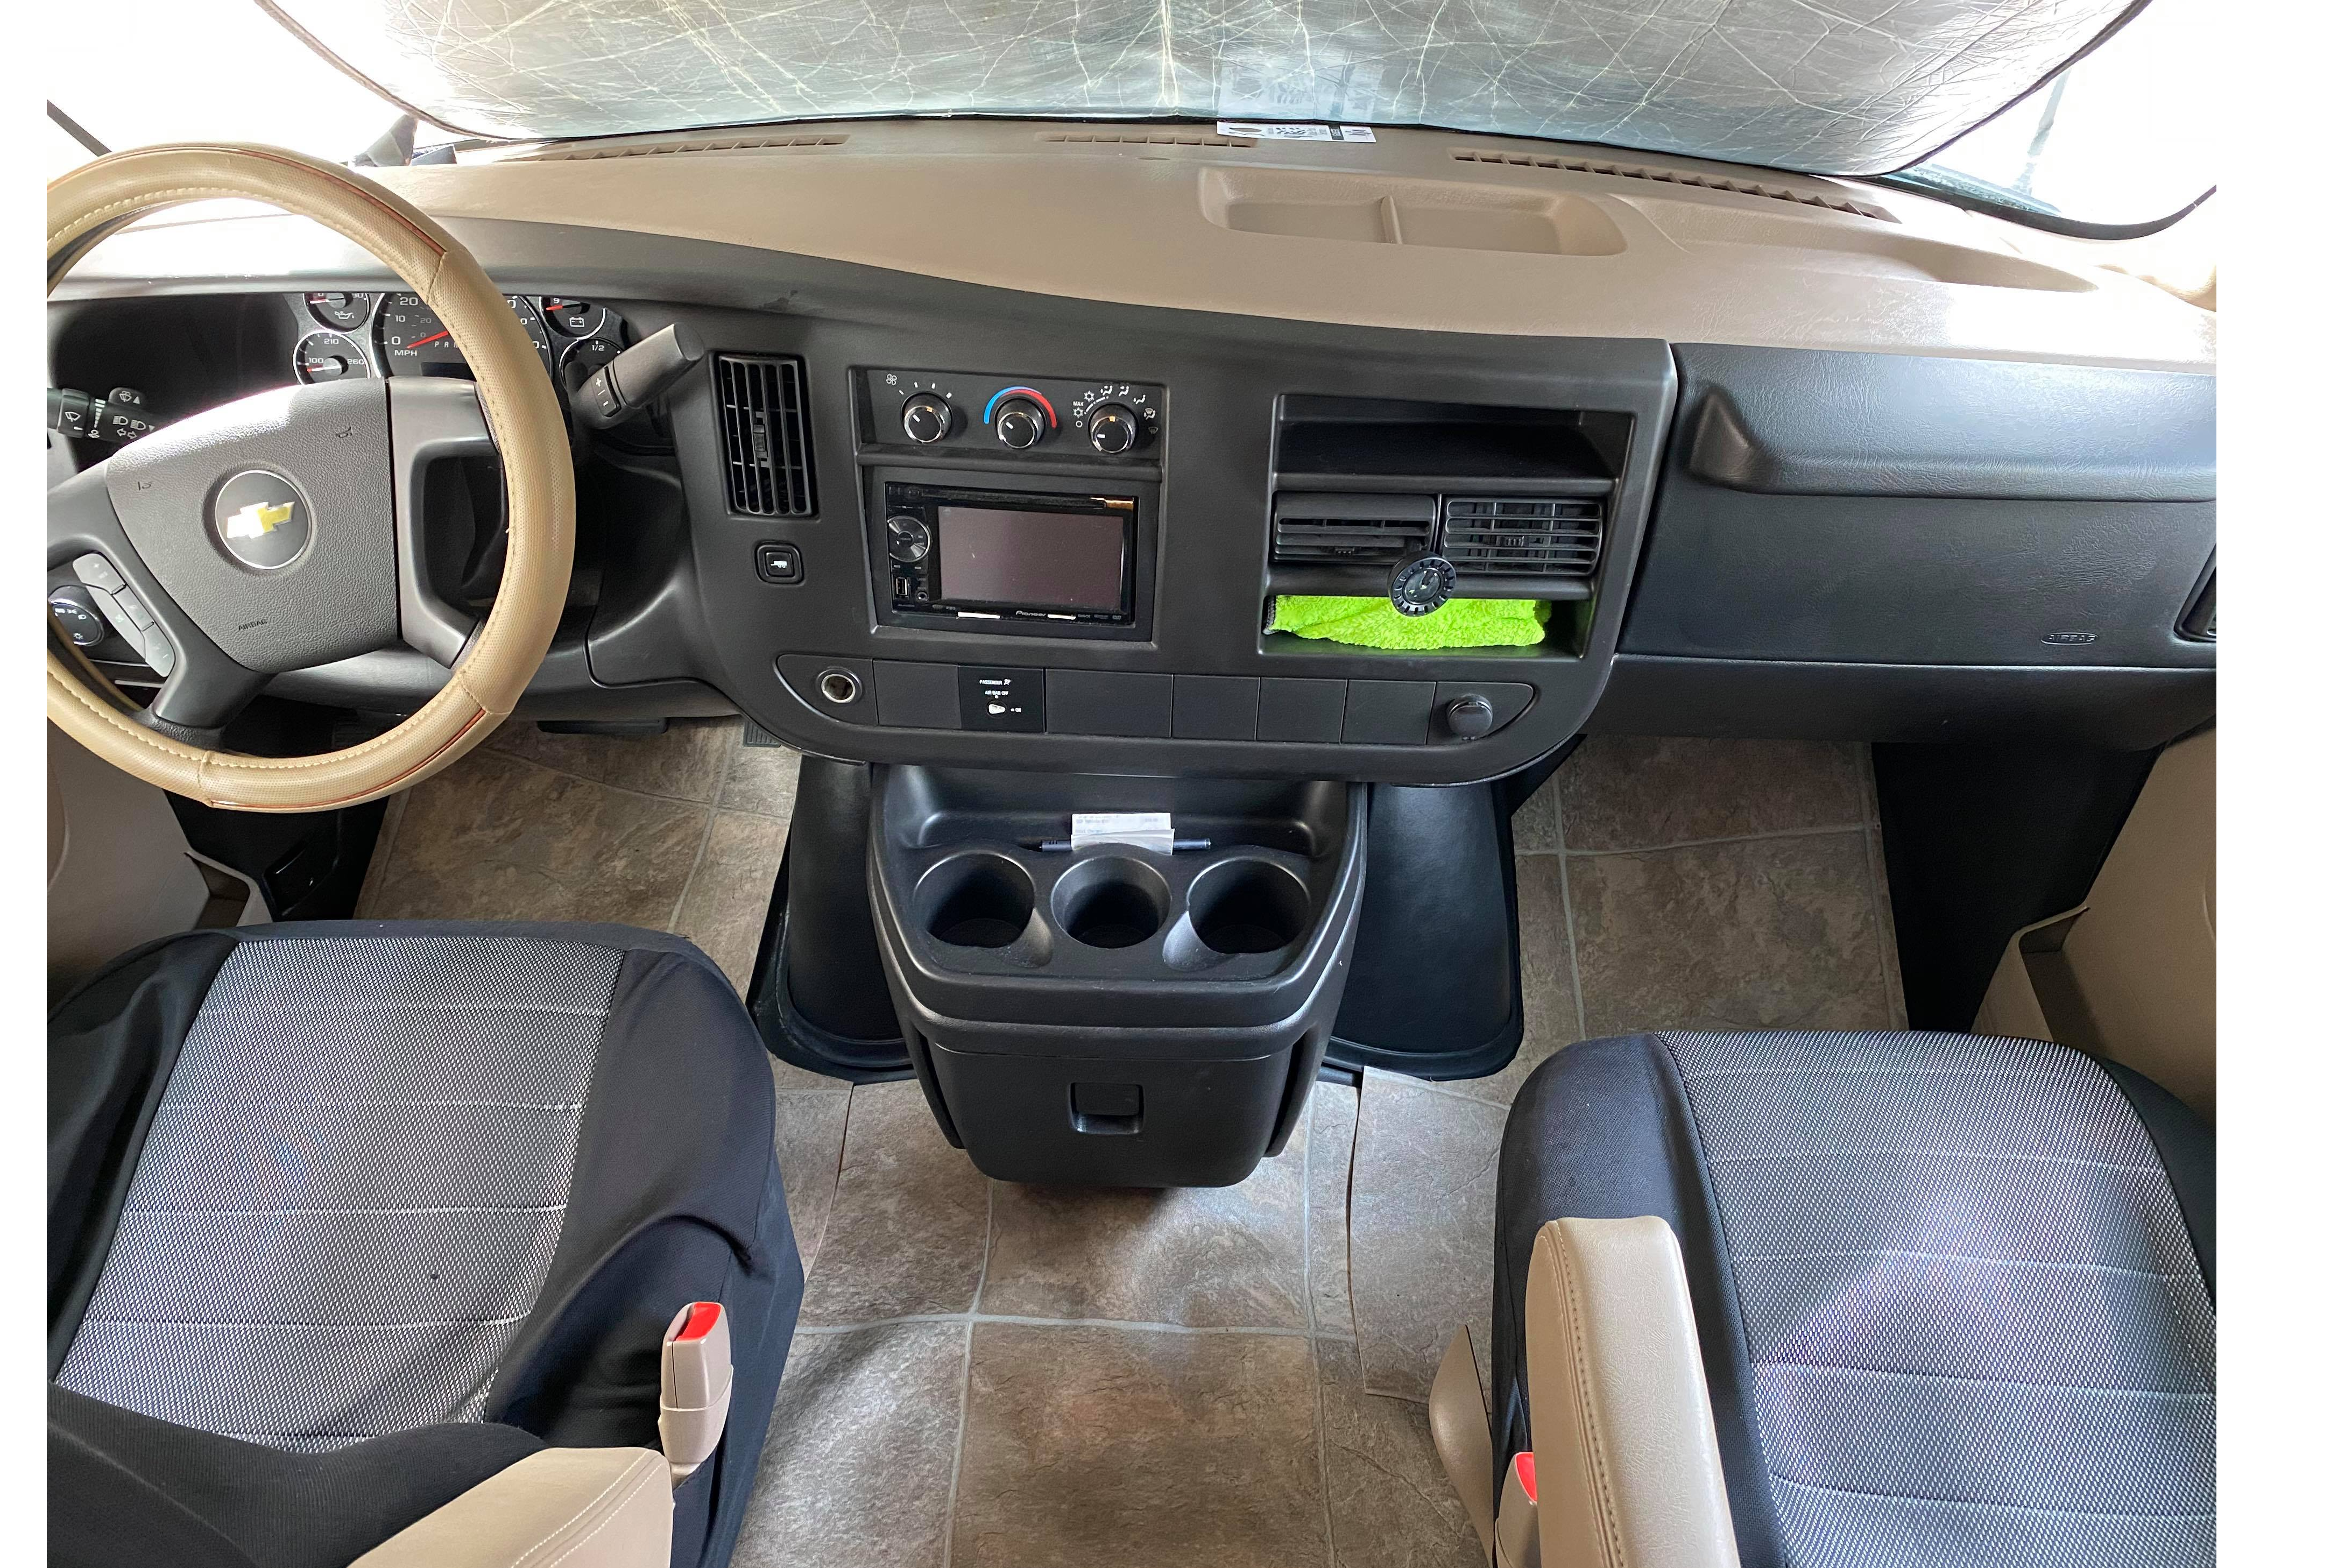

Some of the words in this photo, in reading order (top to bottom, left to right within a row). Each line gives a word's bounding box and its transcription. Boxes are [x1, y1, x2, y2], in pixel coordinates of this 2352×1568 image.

[399, 297, 419, 306] 20
[391, 336, 401, 345] 0
[238, 619, 268, 631] AIRBAG
